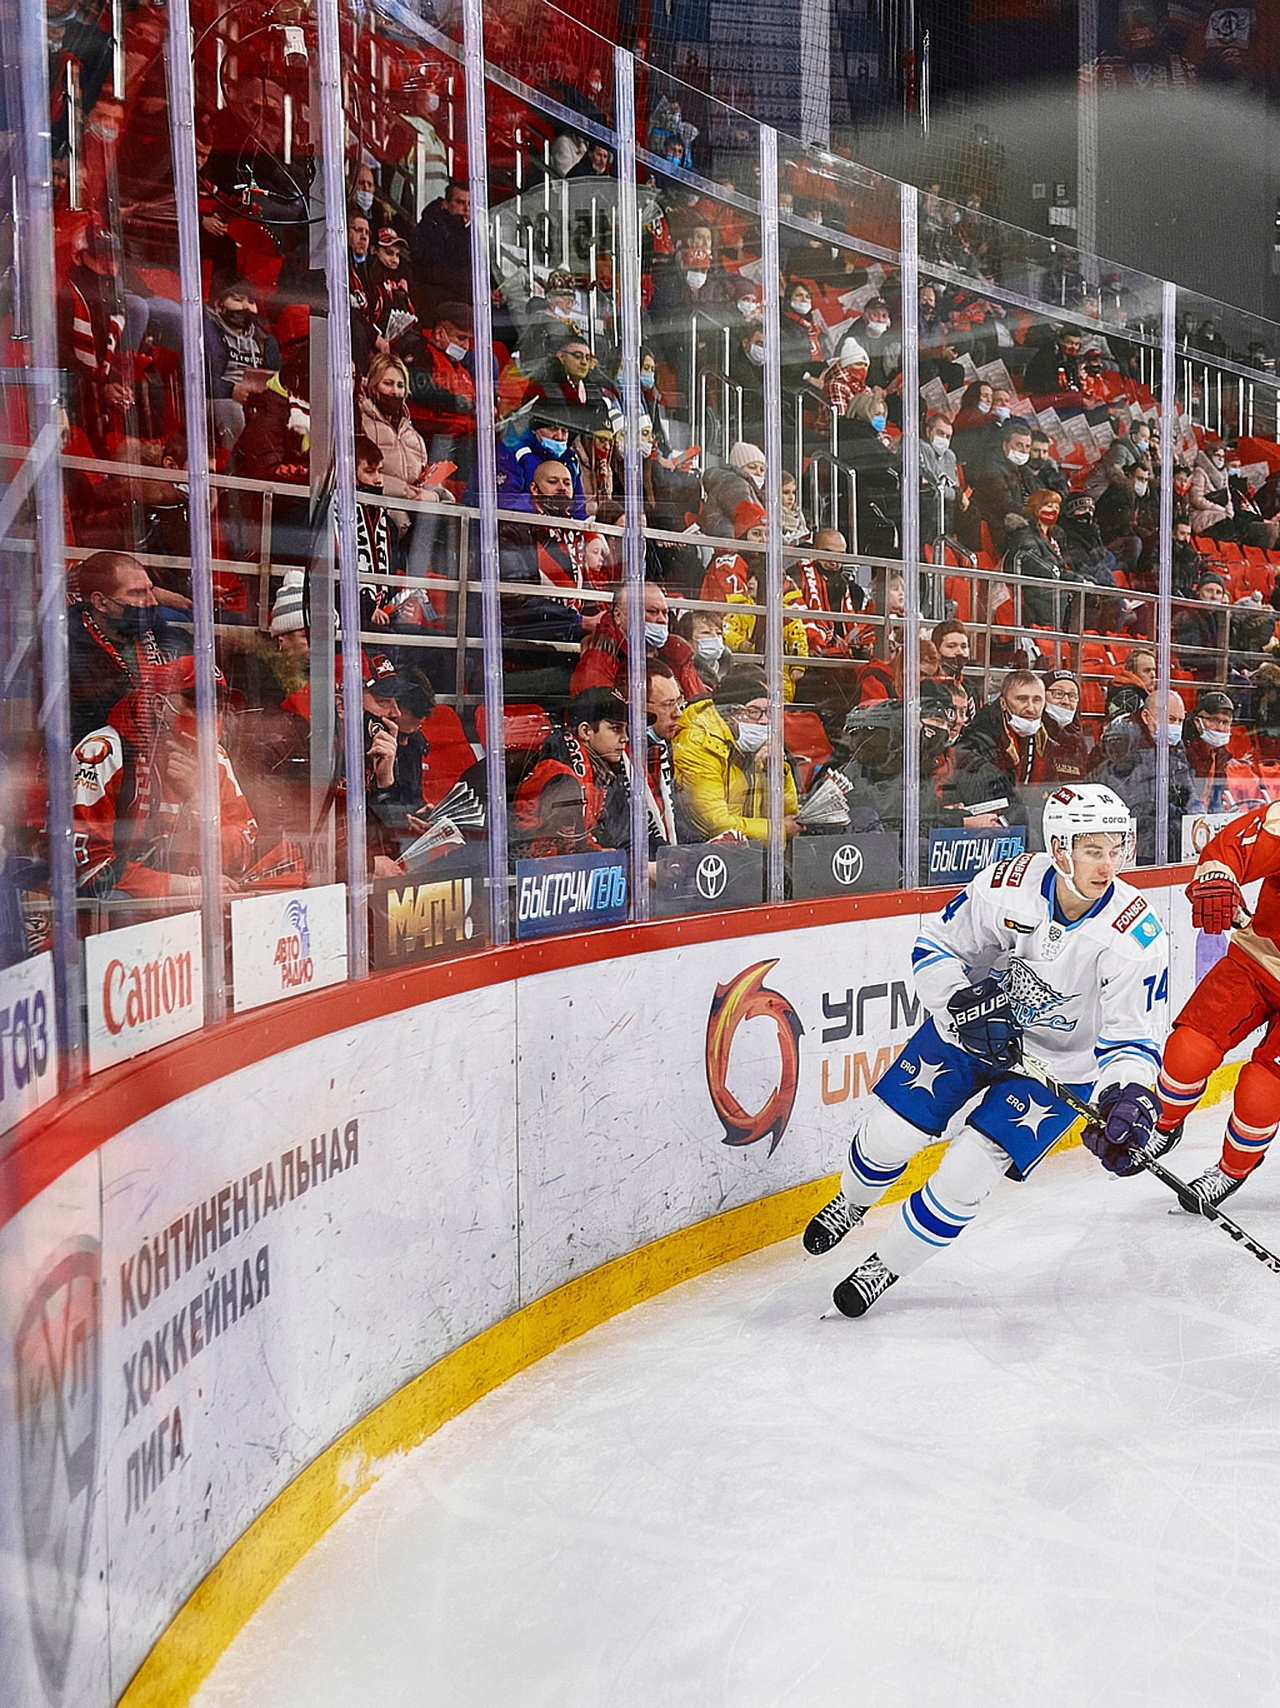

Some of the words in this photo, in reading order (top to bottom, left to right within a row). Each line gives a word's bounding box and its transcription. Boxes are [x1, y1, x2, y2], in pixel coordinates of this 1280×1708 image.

[274, 935, 299, 966] АВТО
[281, 959, 314, 989] РАДИО
[103, 950, 192, 1035] Canon
[821, 980, 934, 1043] УГМ
[1006, 1094, 1026, 1113] ERG
[120, 1119, 359, 1328] КОНТИНЕНТАЛЬНАЯ
[123, 1245, 270, 1428] ХОККЕЙНАЯ
[125, 1405, 187, 1525] ЛИГА
